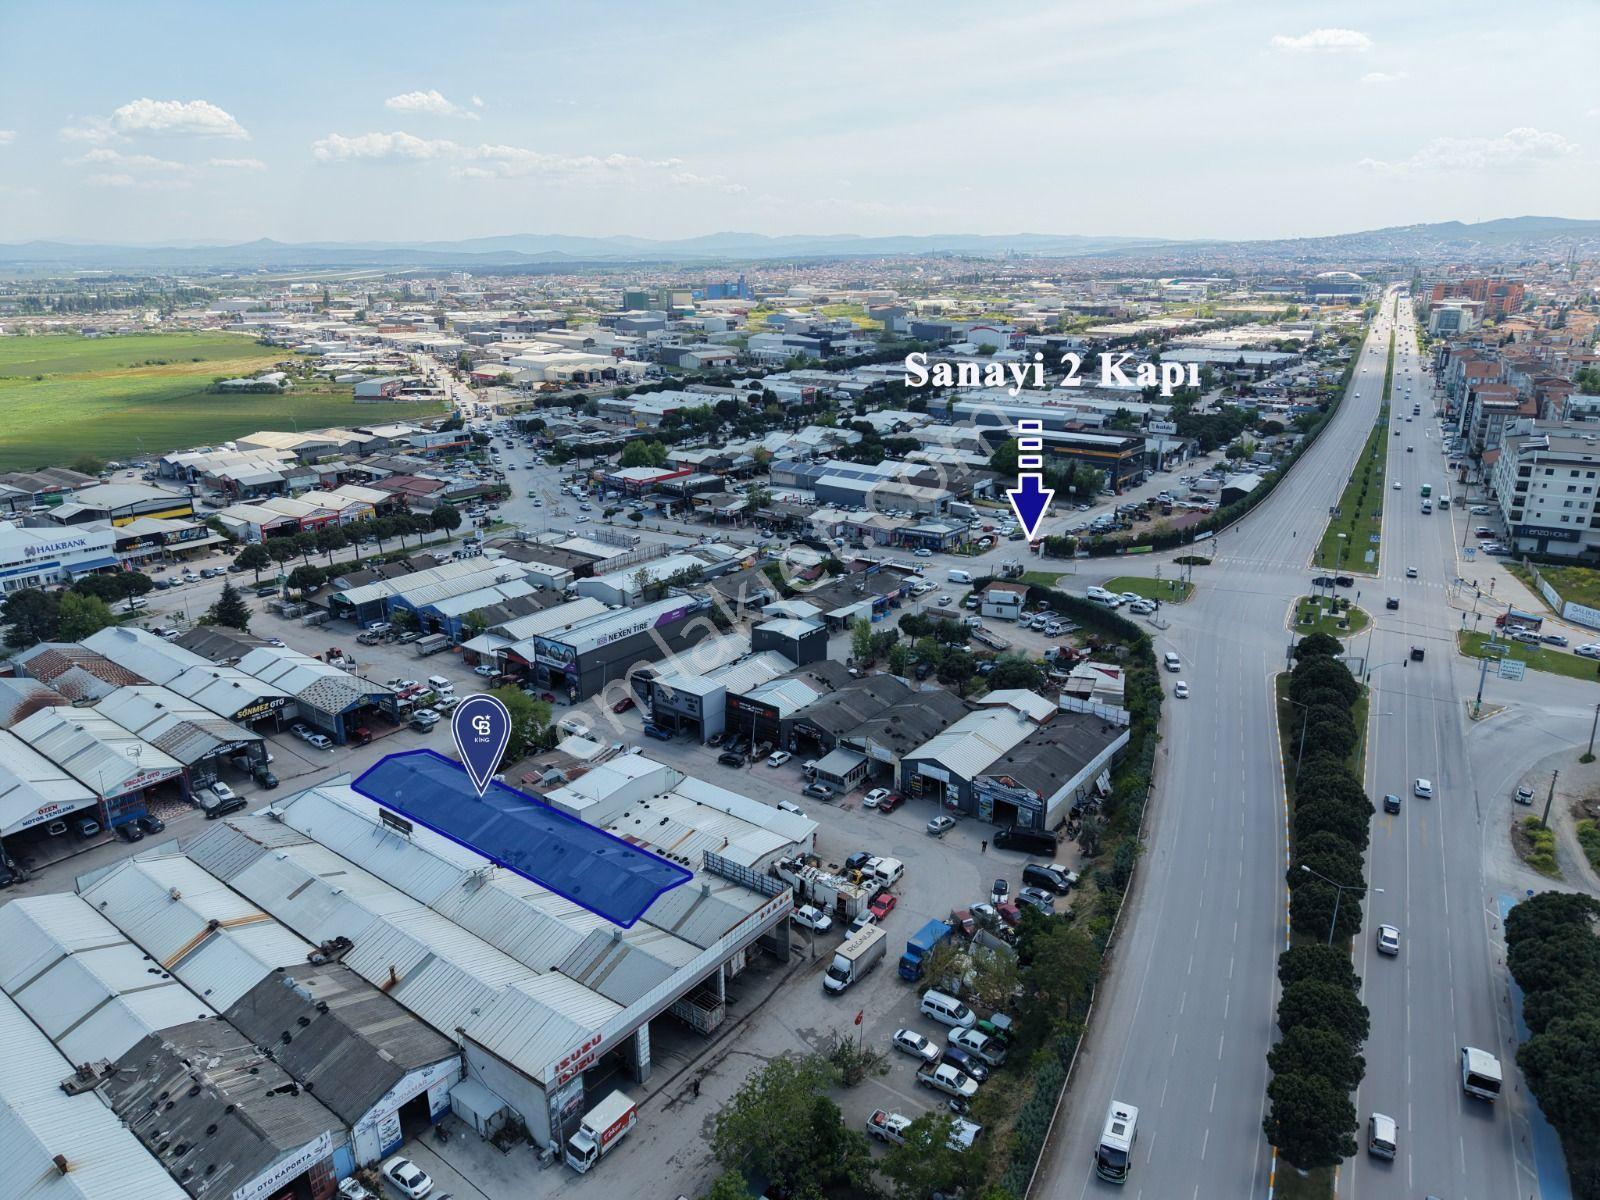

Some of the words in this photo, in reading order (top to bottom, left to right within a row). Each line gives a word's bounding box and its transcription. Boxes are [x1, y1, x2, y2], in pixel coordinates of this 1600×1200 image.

[36, 538, 86, 554] HALKBANK
[608, 628, 632, 641] NEXEN
[633, 621, 649, 633] TIRE
[236, 702, 270, 719] SÖNMEZ
[269, 697, 285, 709] OTO
[147, 770, 160, 780] OTO
[847, 927, 877, 953] REGNUM
[554, 1034, 602, 1073] ISUZU
[557, 1052, 596, 1086] ISUZU
[256, 1177, 274, 1192] OTO
[274, 1152, 312, 1179] KAPORTA
